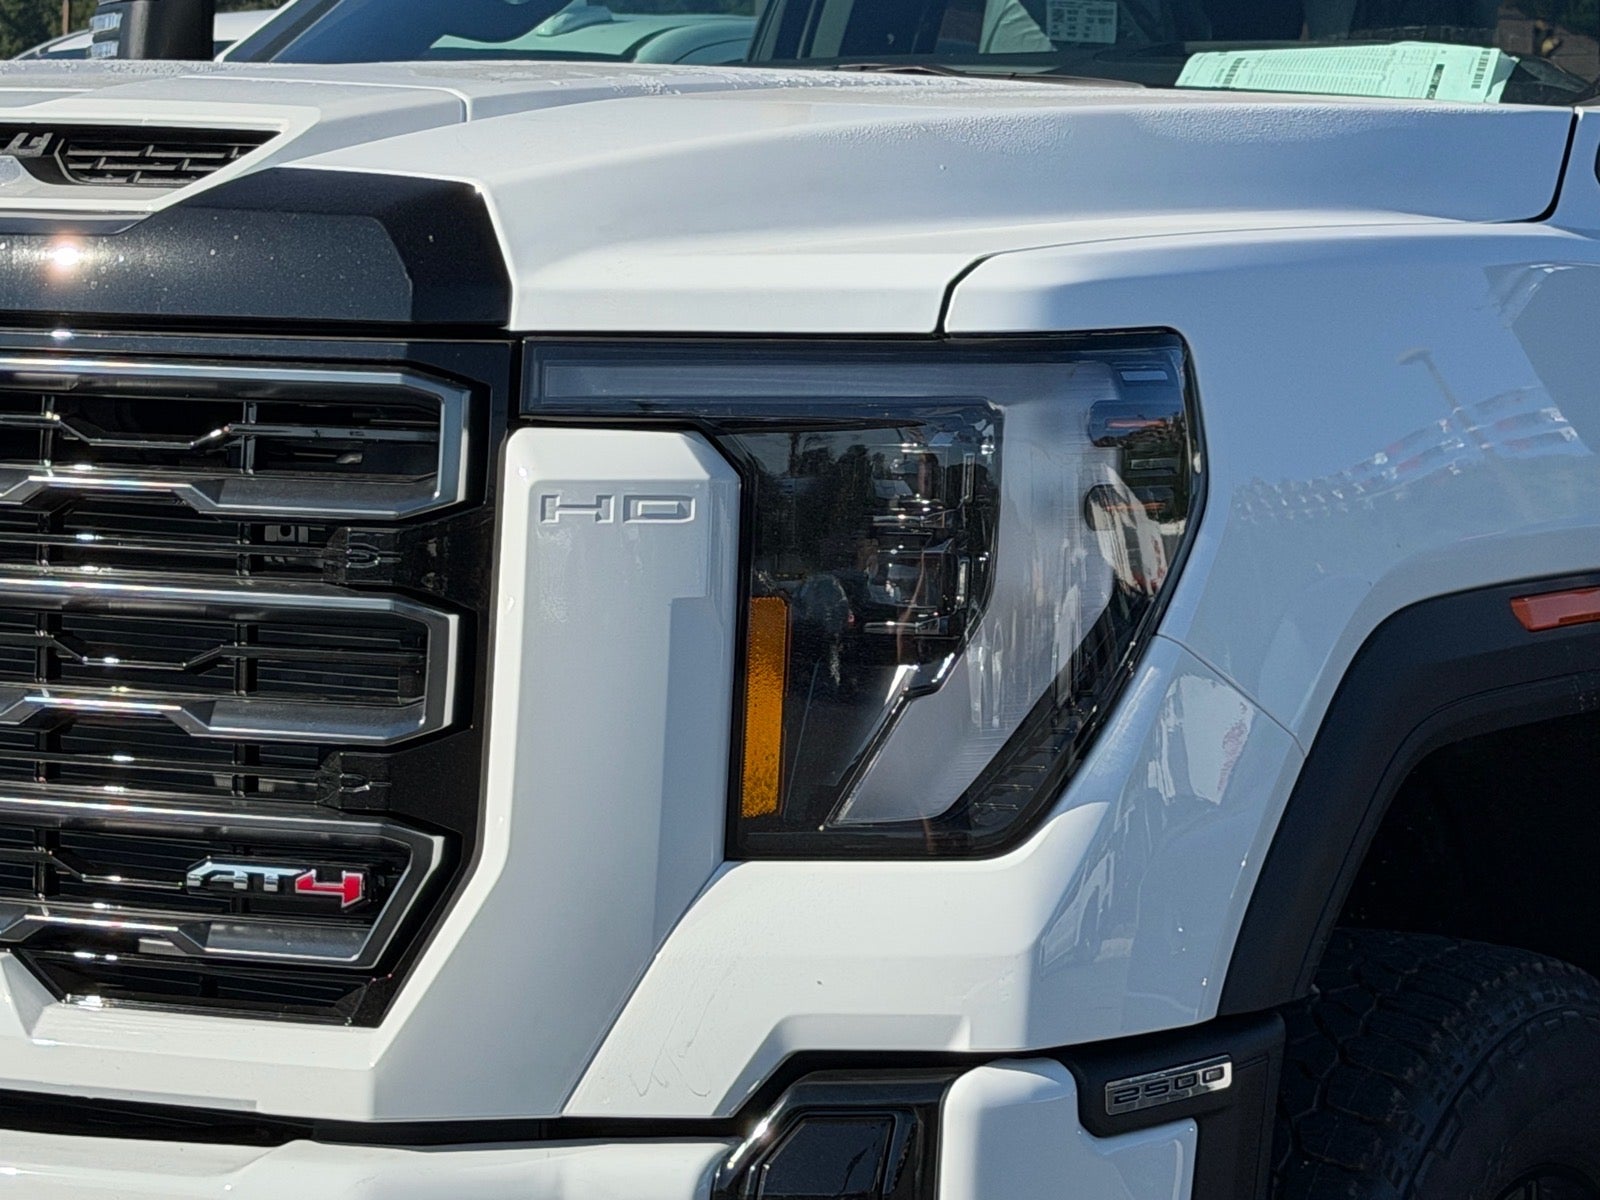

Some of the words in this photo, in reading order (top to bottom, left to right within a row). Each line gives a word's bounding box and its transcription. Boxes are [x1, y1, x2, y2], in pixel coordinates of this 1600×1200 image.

[540, 494, 696, 524] HD
[186, 861, 363, 908] AT4
[1112, 1065, 1226, 1105] 2500
